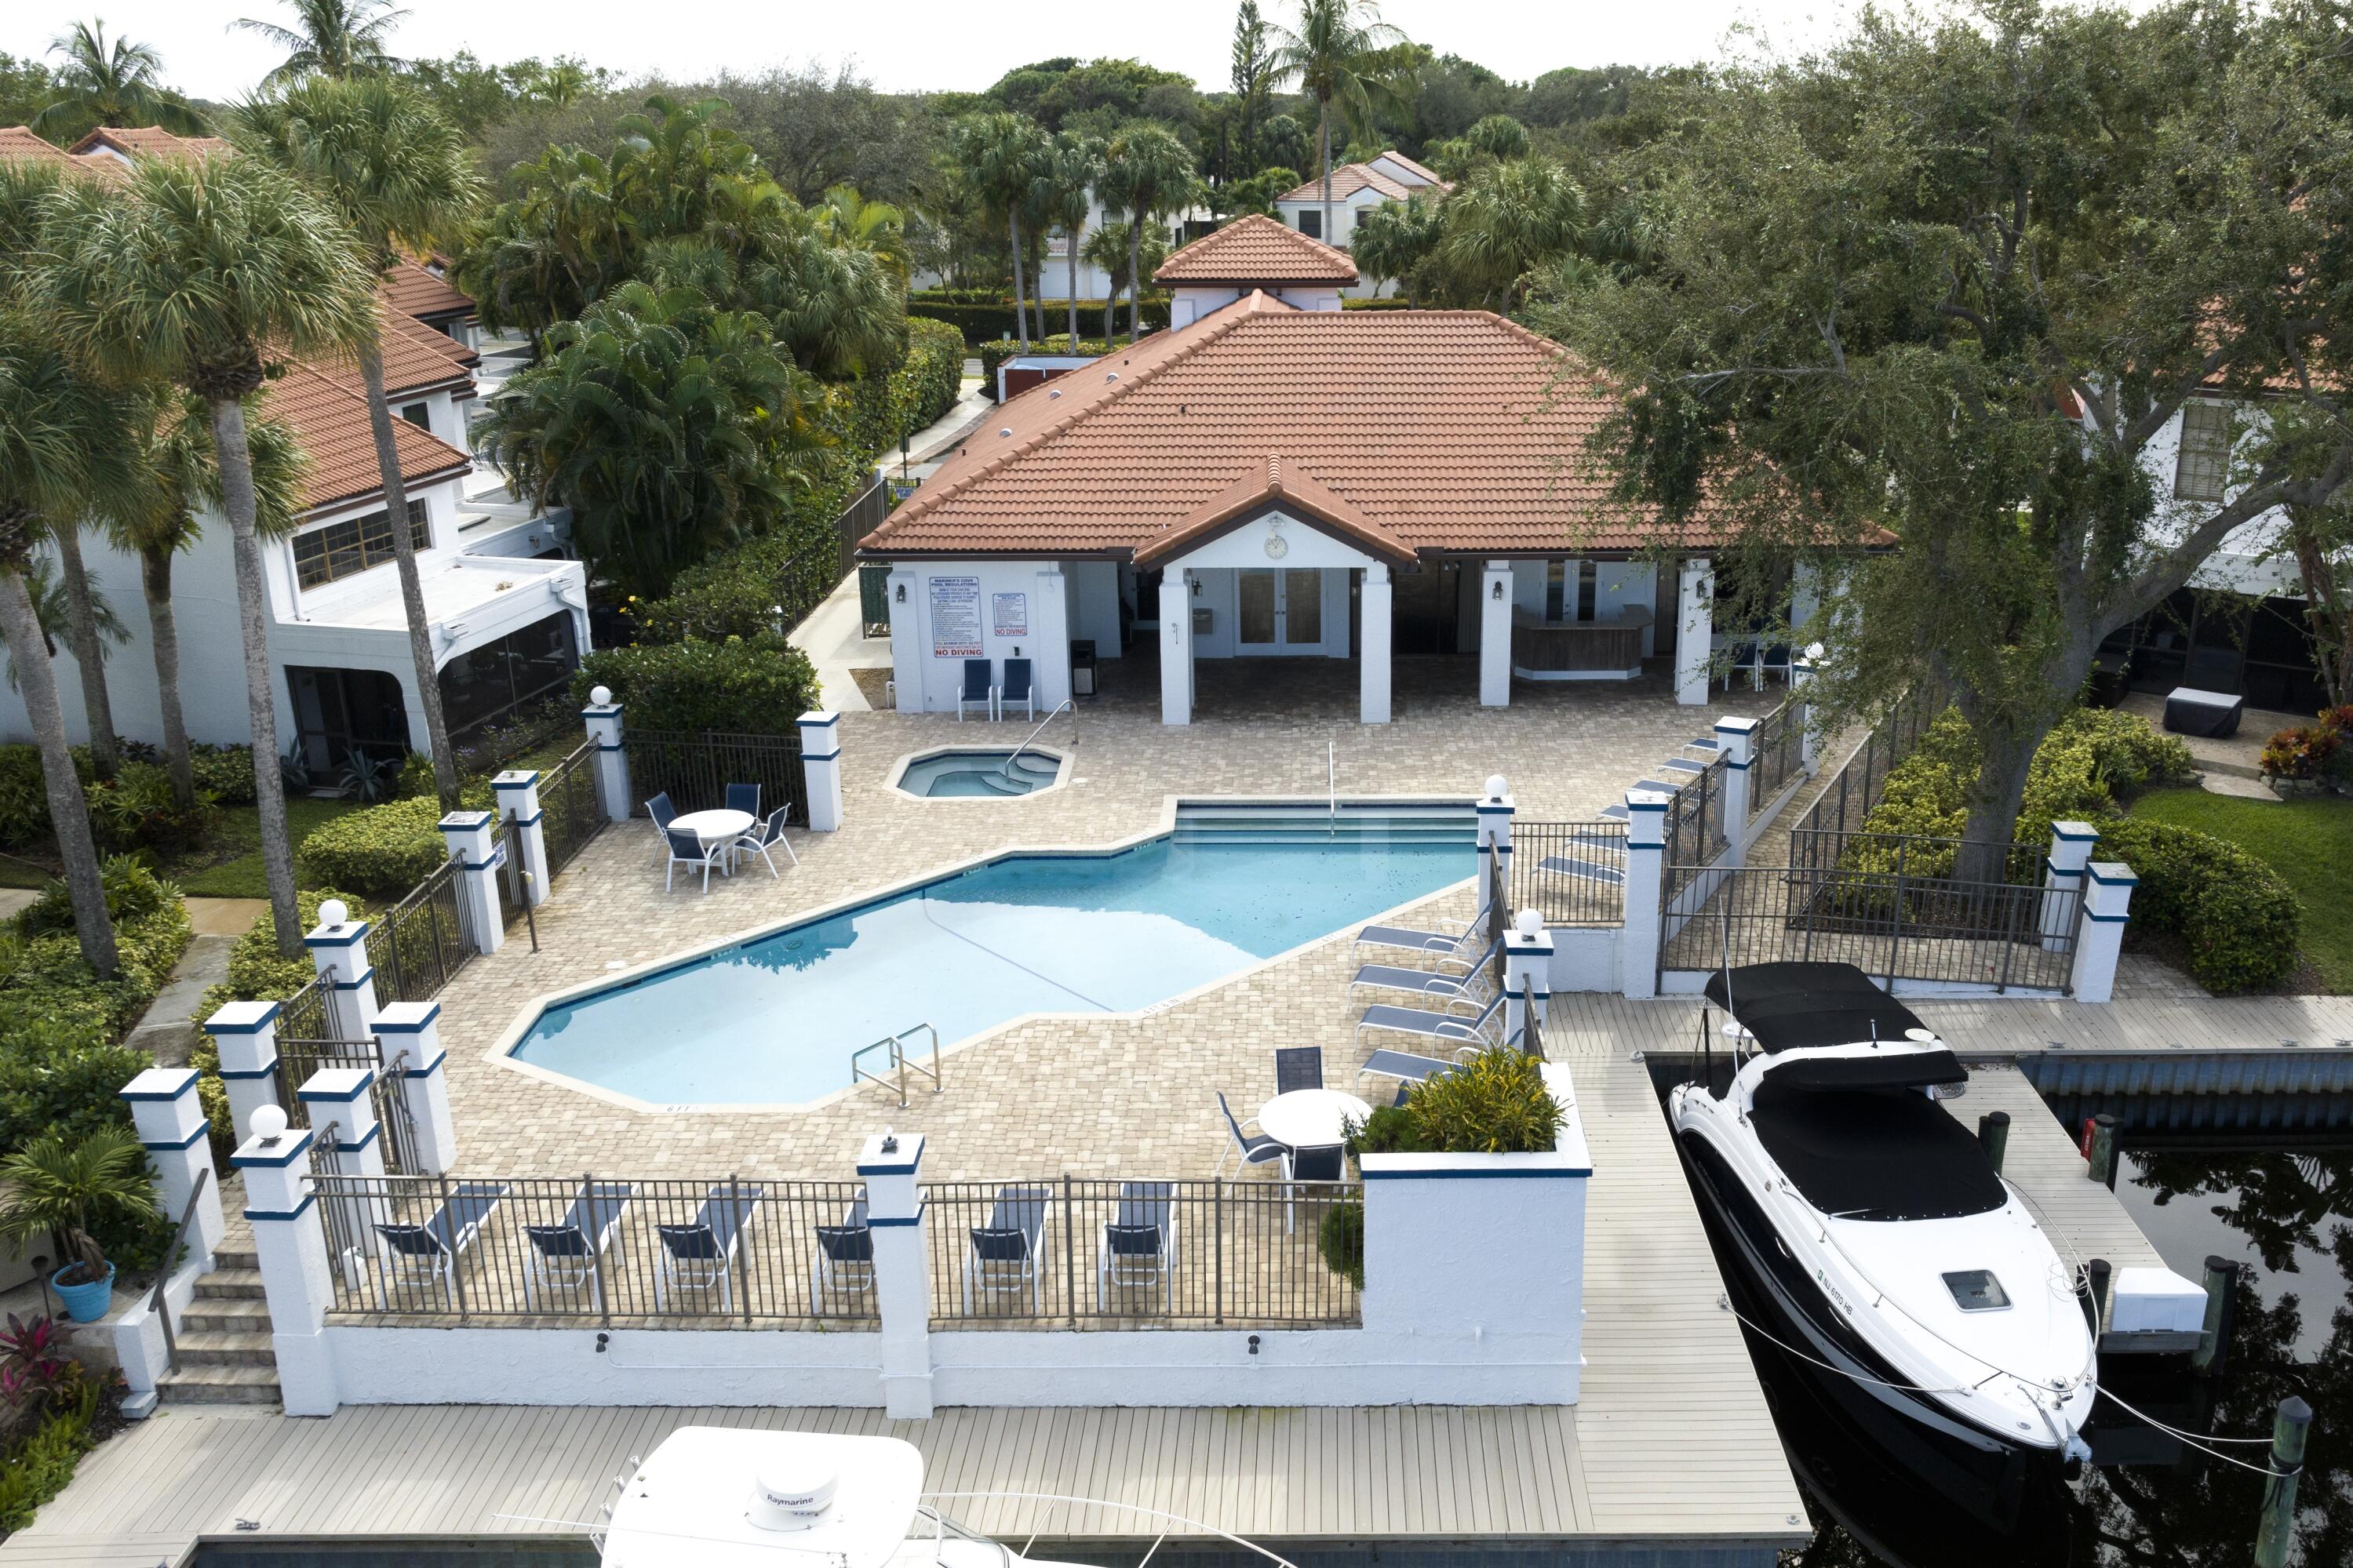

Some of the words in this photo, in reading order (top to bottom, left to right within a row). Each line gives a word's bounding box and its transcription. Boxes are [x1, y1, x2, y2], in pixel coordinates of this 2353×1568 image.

[1830, 1287, 1844, 1305] 6170
[1844, 1301, 1853, 1315] HB
[767, 1493, 814, 1506] Raymarine
